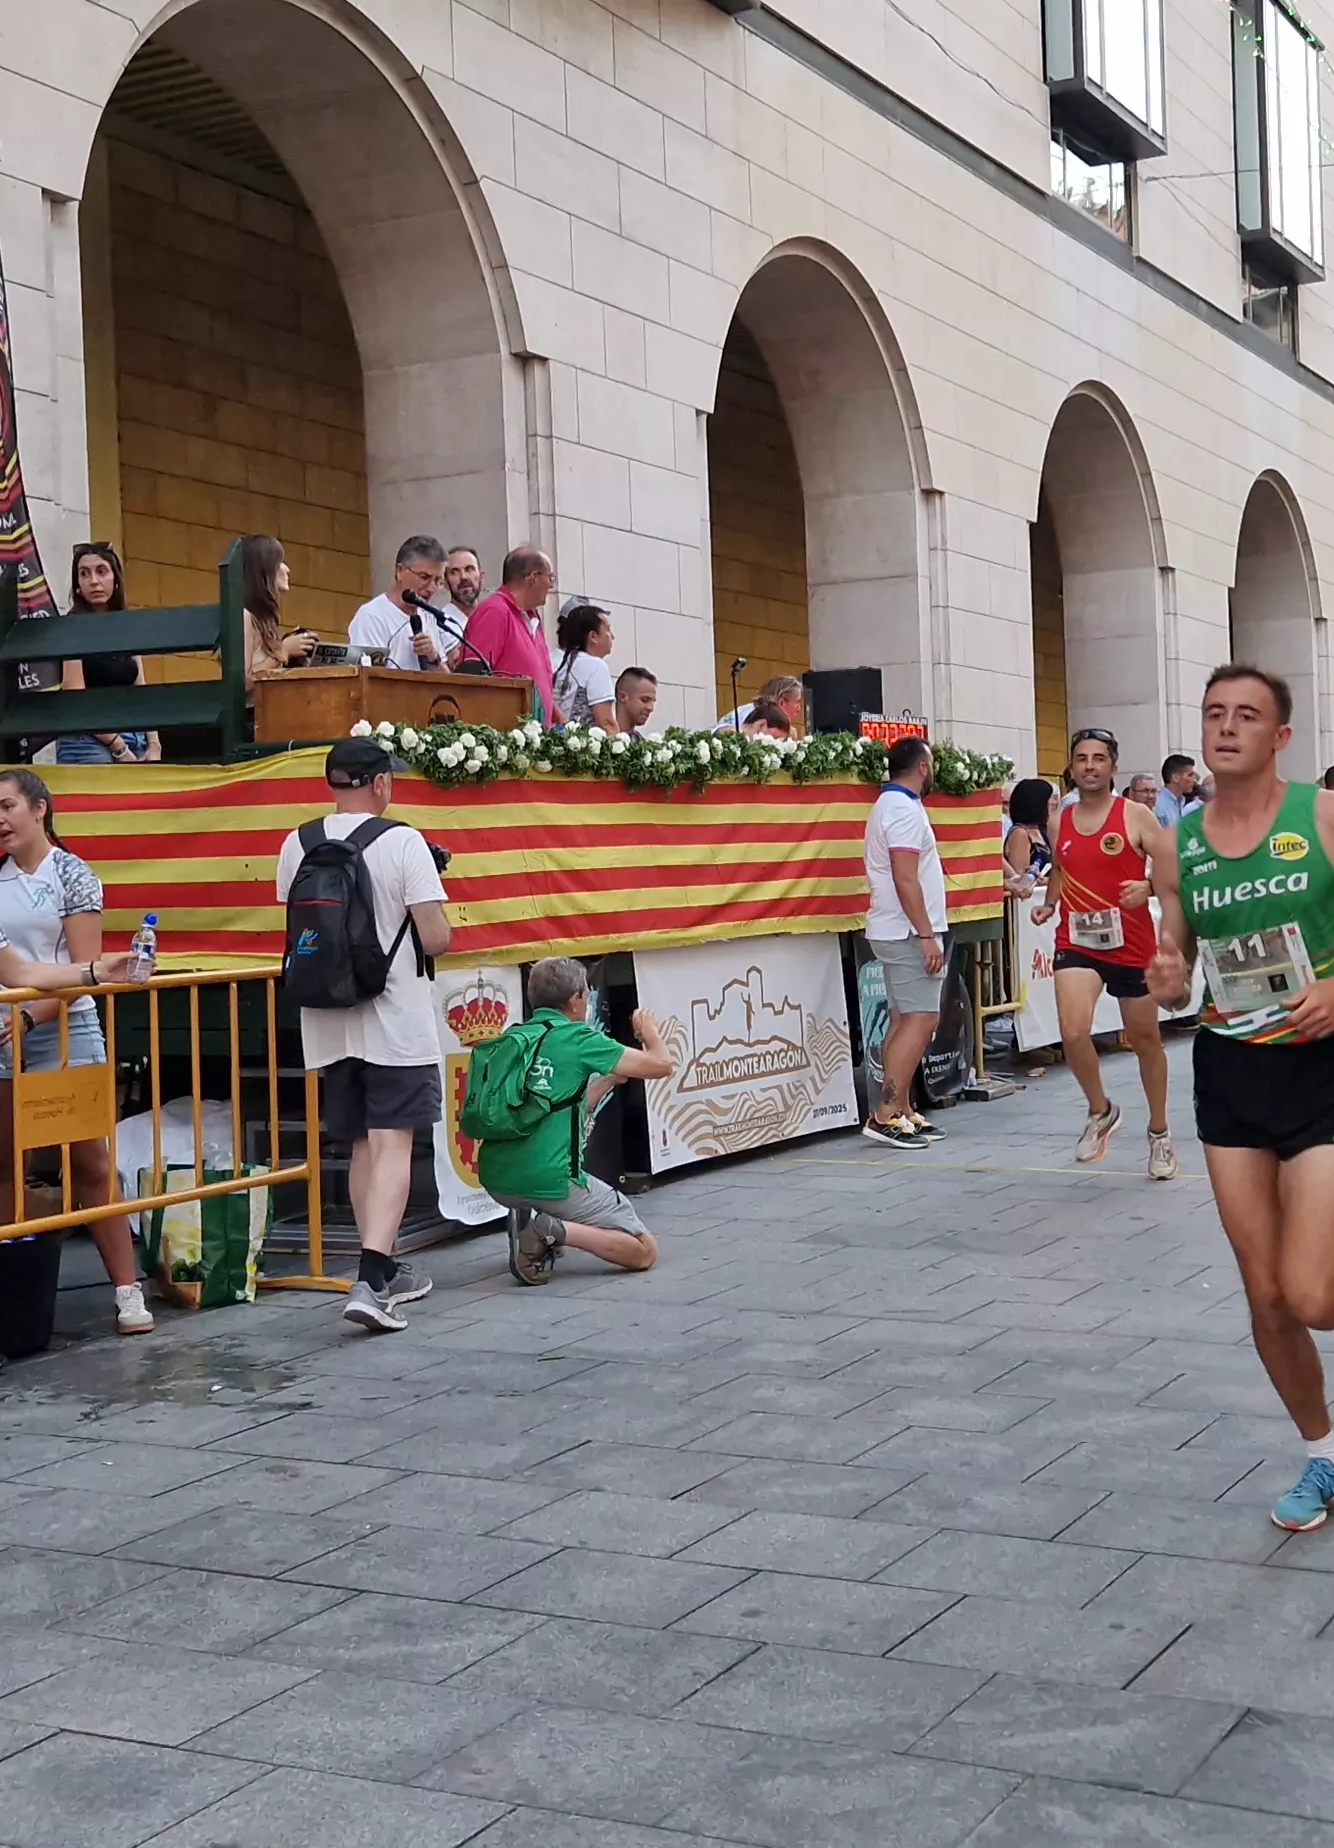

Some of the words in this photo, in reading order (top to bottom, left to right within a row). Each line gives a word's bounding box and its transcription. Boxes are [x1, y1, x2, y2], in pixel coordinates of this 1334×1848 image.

[1192, 872, 1309, 914] Huesca
[1081, 912, 1104, 926] 14
[1228, 933, 1267, 962] 11
